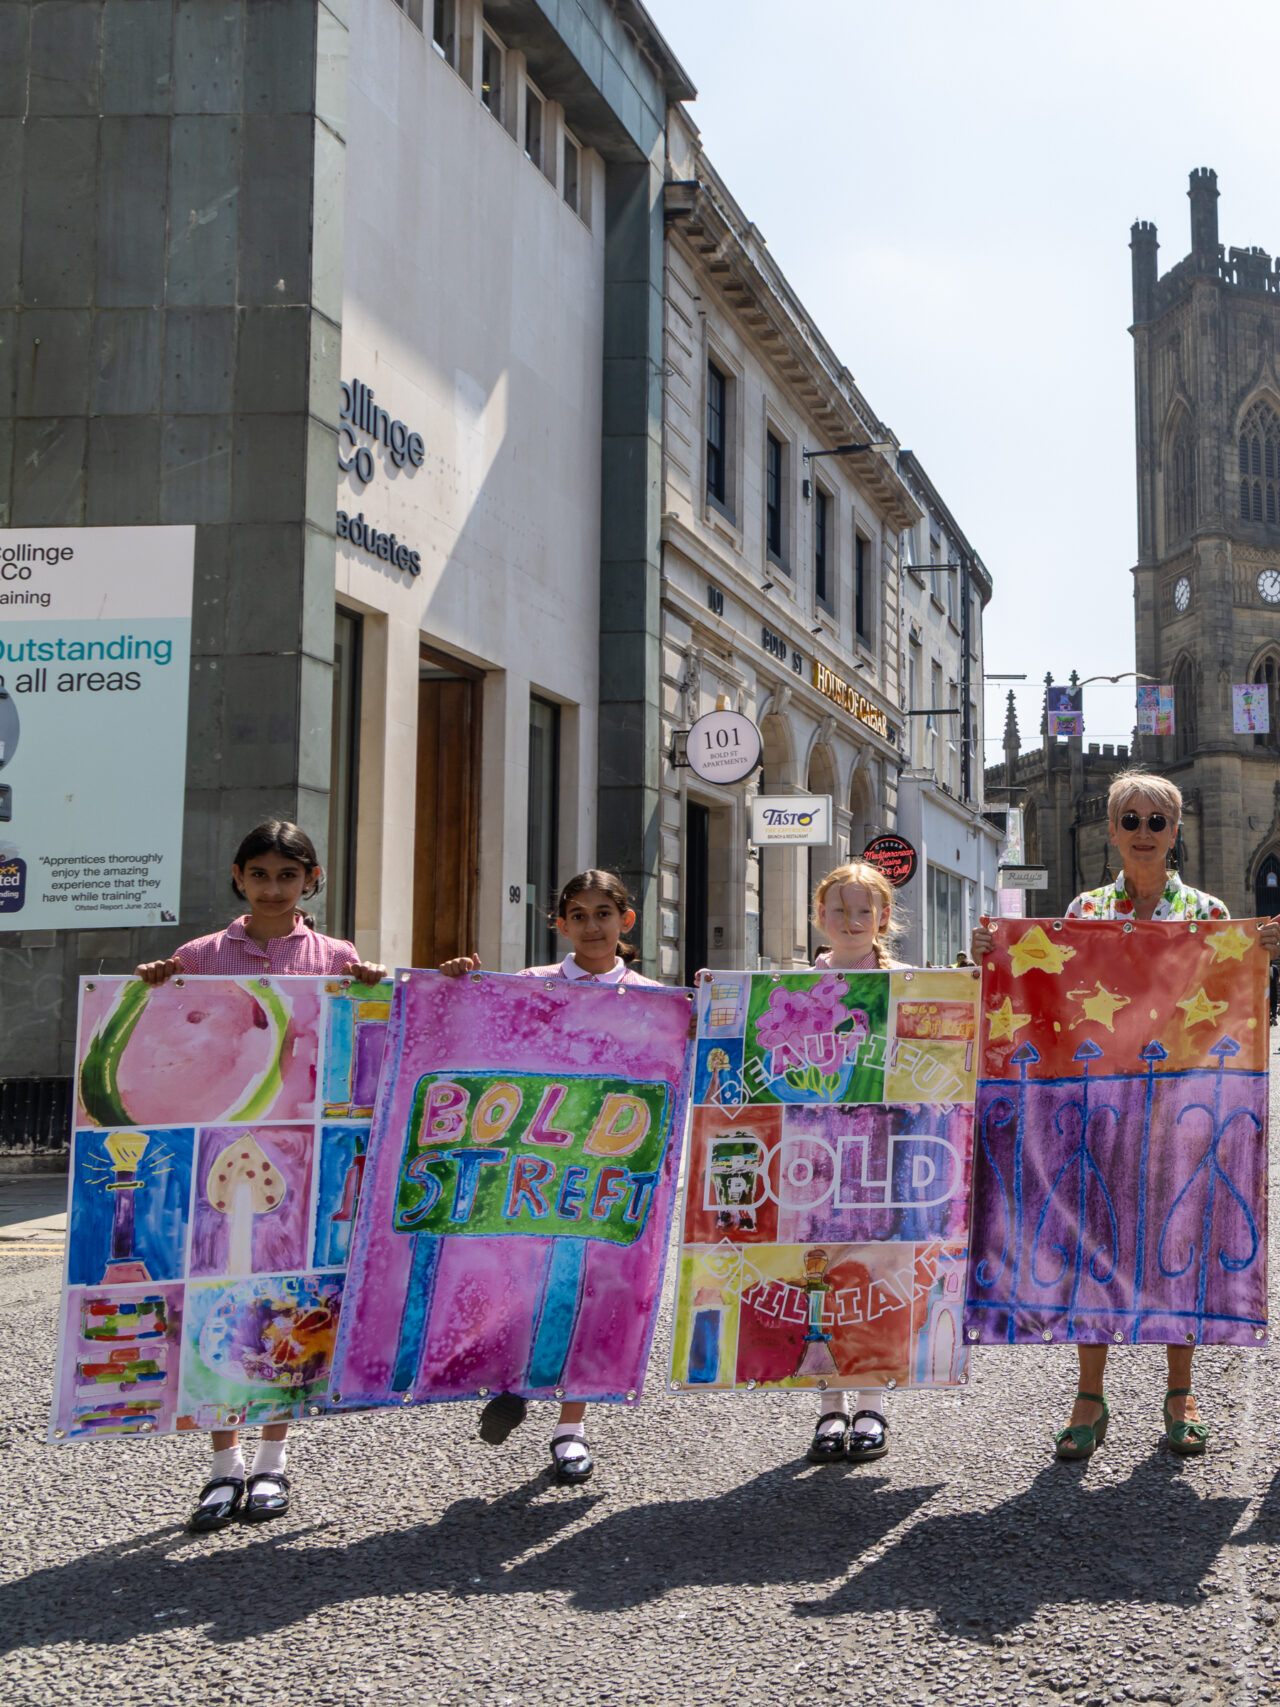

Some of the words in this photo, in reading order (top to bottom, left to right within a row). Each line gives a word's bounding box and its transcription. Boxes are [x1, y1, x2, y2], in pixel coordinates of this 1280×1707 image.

[0, 544, 74, 566] ollinge
[15, 667, 47, 693] all
[56, 671, 142, 693] areas
[817, 662, 847, 707] HOUSE
[848, 688, 860, 717] OF
[860, 696, 887, 739] CAESAR
[704, 728, 741, 750] 101
[702, 757, 748, 769] APARTMENTS
[710, 751, 730, 760] BOLD
[730, 750, 738, 758] ST
[108, 853, 164, 865] thoroughly
[51, 868, 80, 879] enjoy
[83, 868, 101, 877] the
[103, 866, 149, 877] amazing
[1008, 872, 1042, 882] Rudy's
[51, 880, 111, 890] experience
[114, 879, 135, 888] that
[138, 878, 161, 889] they
[42, 893, 68, 902] have
[71, 892, 99, 902] while
[509, 885, 521, 904] 99
[100, 903, 124, 911] Report
[711, 1032, 963, 1120] BEAUTIFUL
[417, 1081, 650, 1157] BOLD
[703, 1134, 963, 1211] BOLD
[700, 1236, 958, 1326] BRILLIANT
